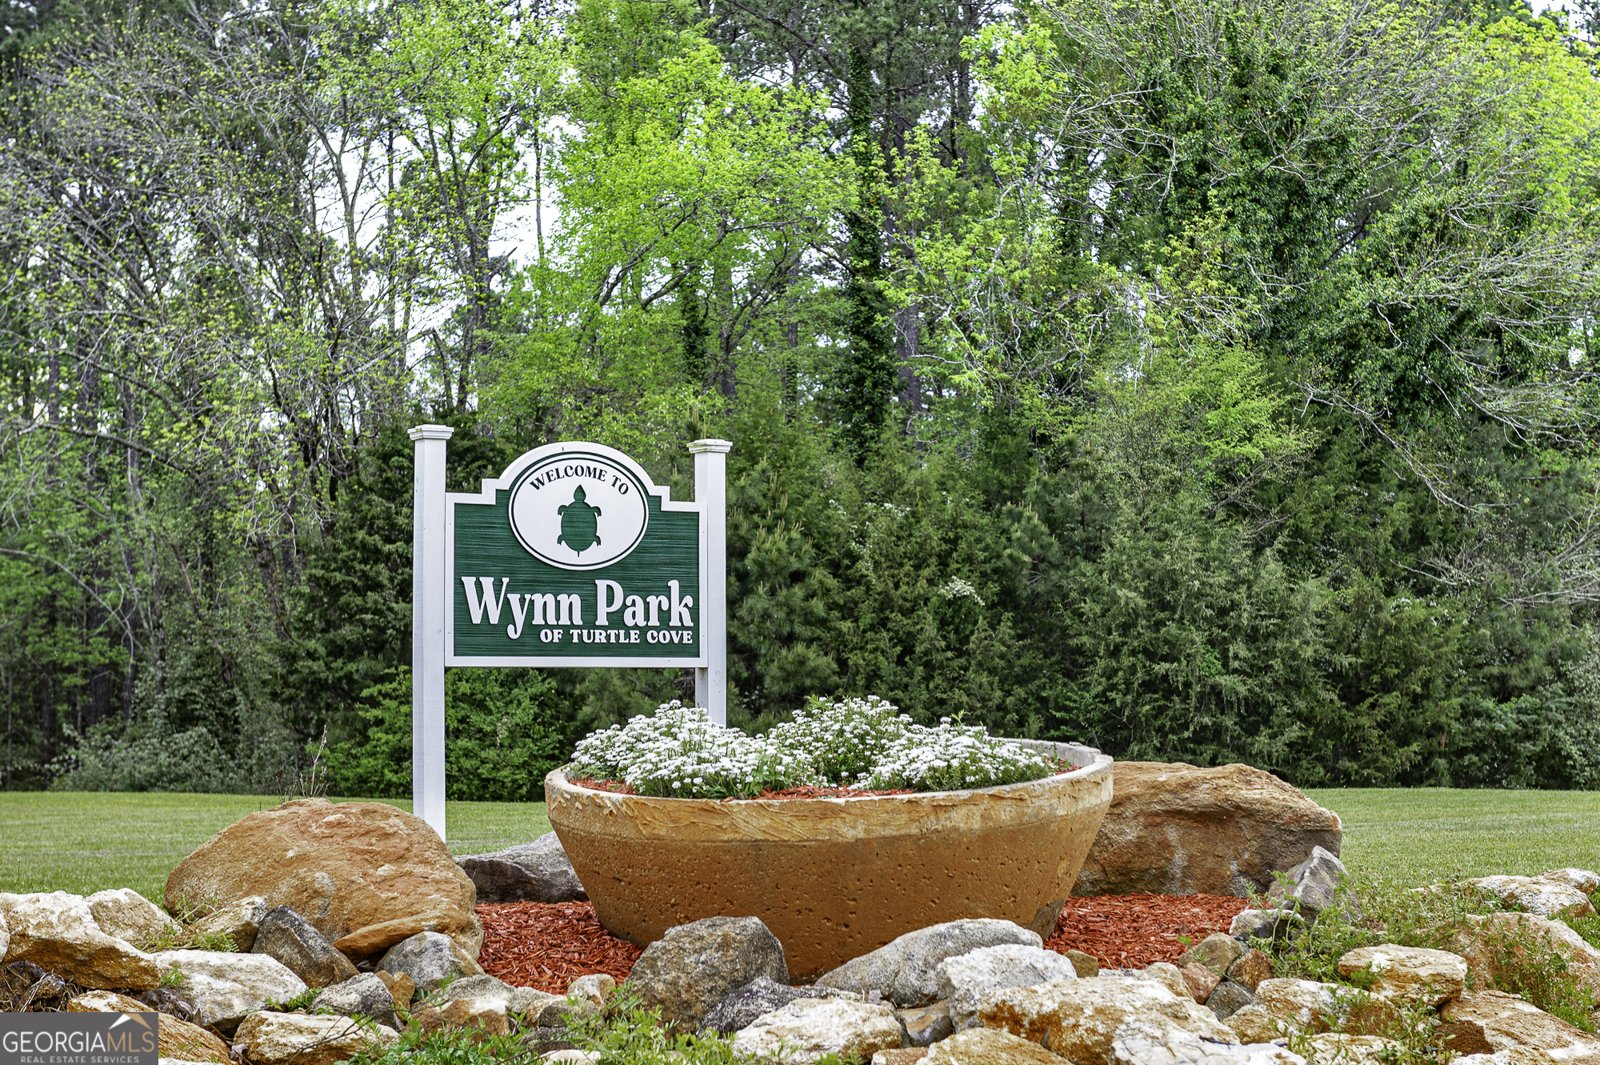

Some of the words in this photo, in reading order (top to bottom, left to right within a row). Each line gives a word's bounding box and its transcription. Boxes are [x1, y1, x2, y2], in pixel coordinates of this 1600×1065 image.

[529, 464, 607, 492] WELCOME
[612, 474, 630, 496] TO
[461, 576, 583, 640] Wynn
[594, 579, 694, 628] Park
[539, 629, 564, 644] OF
[569, 629, 640, 644] TURTLE
[646, 630, 693, 644] COVE
